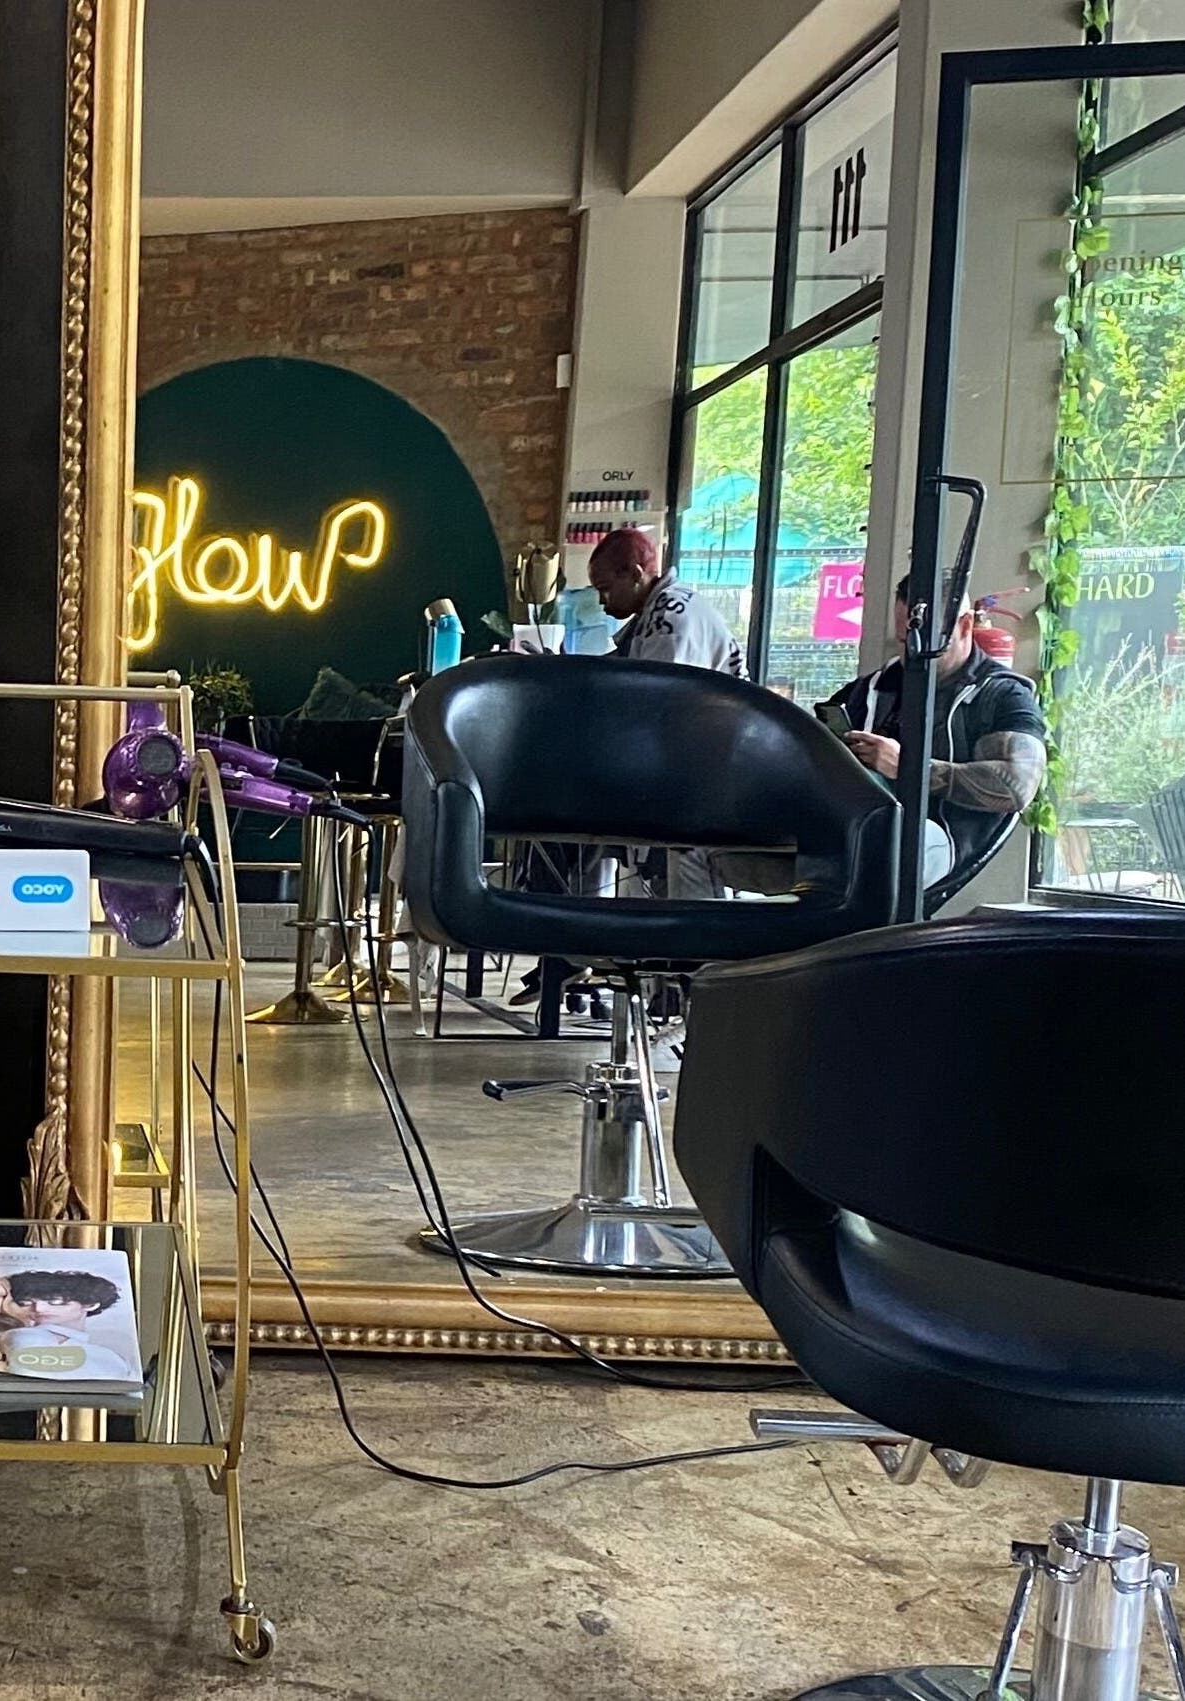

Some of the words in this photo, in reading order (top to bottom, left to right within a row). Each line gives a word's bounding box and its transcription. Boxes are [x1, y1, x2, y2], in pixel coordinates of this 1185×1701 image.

[1076, 249, 1183, 281] pening
[601, 470, 635, 482] ORLY
[126, 476, 386, 651] glow
